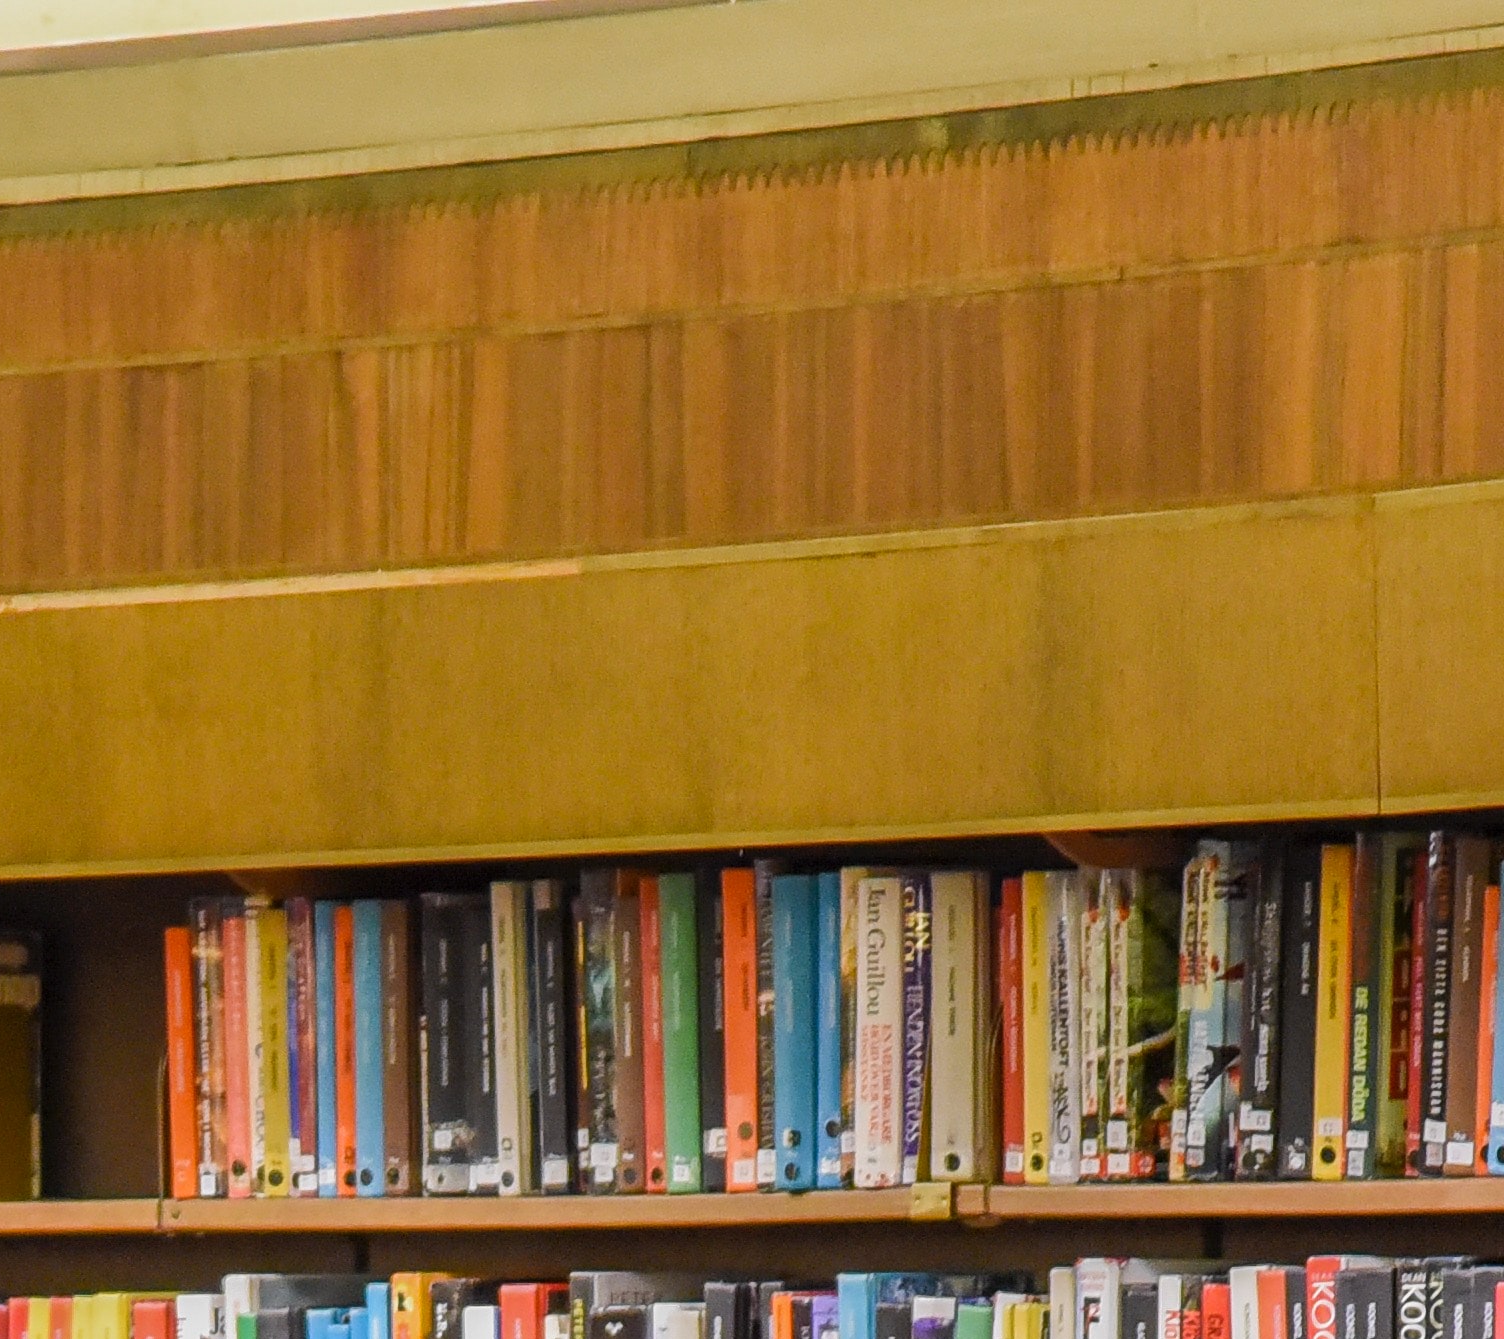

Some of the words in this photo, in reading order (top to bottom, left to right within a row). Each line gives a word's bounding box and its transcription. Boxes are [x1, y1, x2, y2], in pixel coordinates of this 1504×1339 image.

[865, 886, 887, 924] Jan
[865, 928, 887, 1016] Guillou
[1352, 1012, 1370, 1074] REDAN
[1352, 1076, 1372, 1121] DÖDA
